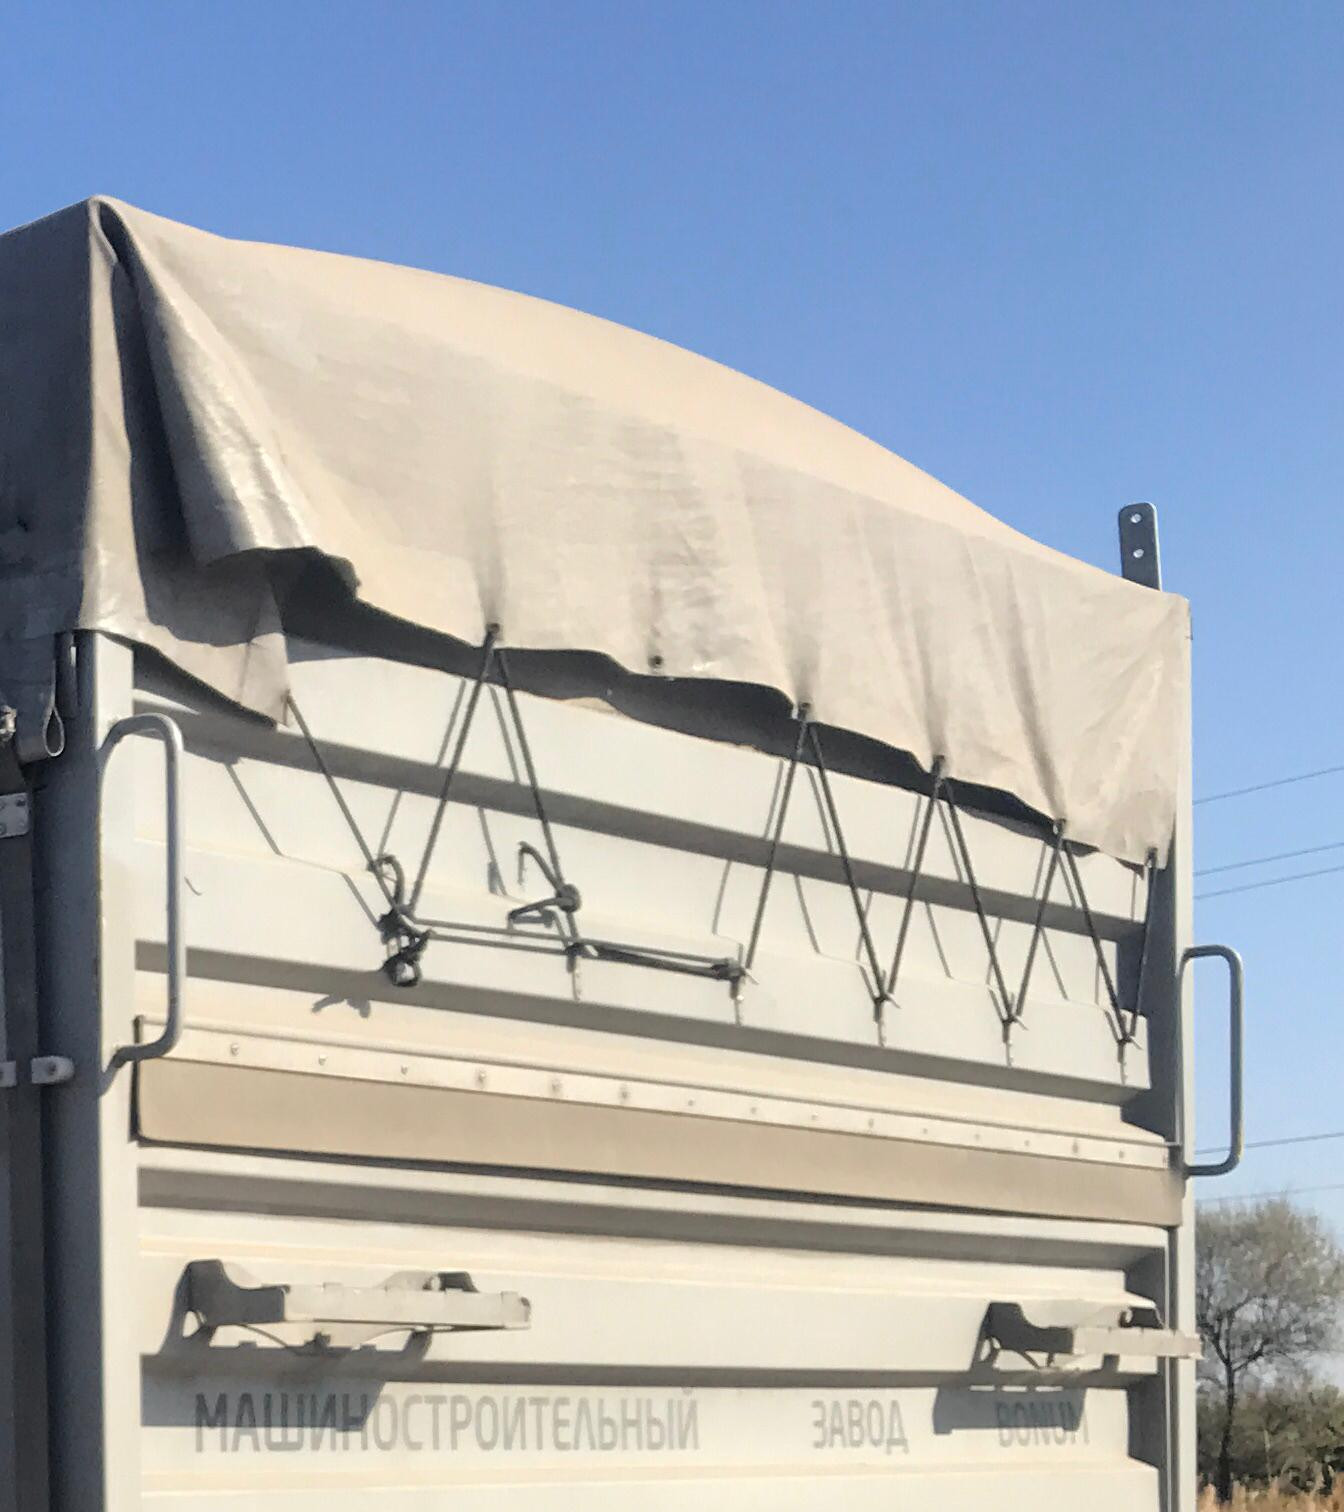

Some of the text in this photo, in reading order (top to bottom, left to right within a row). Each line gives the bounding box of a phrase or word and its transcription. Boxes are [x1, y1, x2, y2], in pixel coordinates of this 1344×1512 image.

[194, 1385, 1090, 1455] МАШИНОСТРОИТЕЛЬНЫЙ ЗАВОД BONUM
